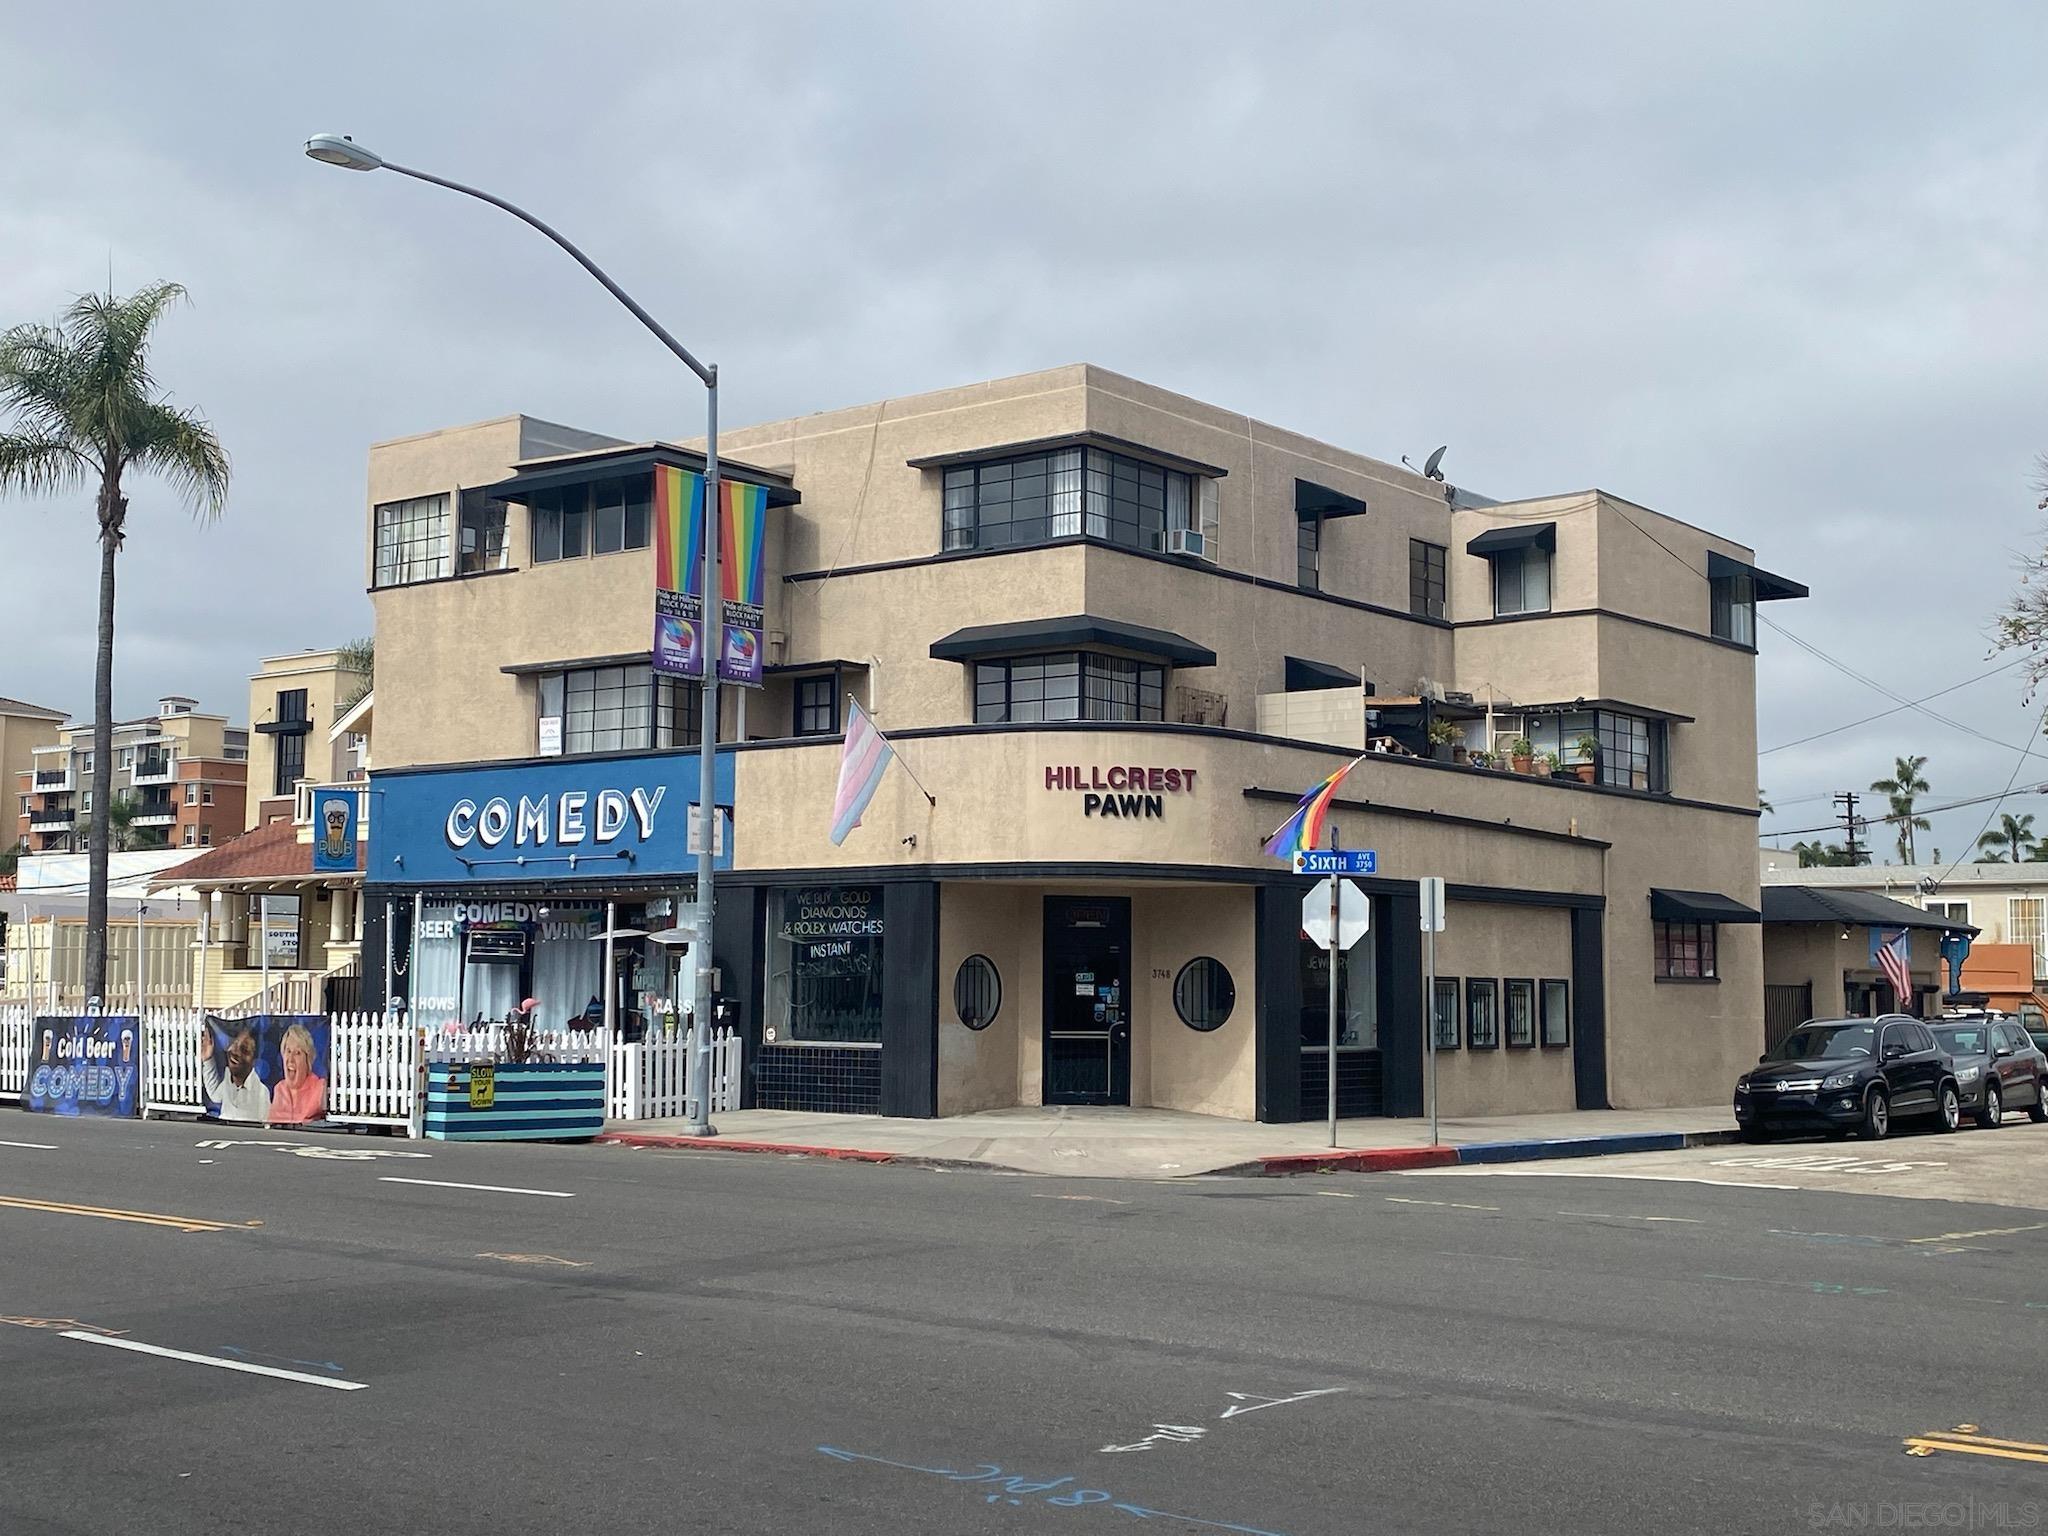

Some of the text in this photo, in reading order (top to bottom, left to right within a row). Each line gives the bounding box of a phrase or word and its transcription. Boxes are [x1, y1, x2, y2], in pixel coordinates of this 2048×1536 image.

[660, 599, 699, 611] BLOCK PARTY
[726, 610, 761, 621] BLOCK PARTY
[663, 660, 689, 670] PRIDE
[728, 669, 751, 678] PRIDE
[1045, 766, 1197, 791] HILLCREST
[1084, 793, 1163, 817] PAWN
[446, 786, 667, 848] COMEDY
[318, 840, 353, 856] PUB
[1357, 852, 1370, 860] AVE
[1309, 854, 1347, 870] SIXTH
[1356, 860, 1372, 868] 3750
[814, 891, 832, 904] BUY
[840, 890, 871, 904] GOLD
[453, 901, 540, 923] COMEDY
[800, 905, 868, 920] DIAMONDS
[419, 919, 454, 939] BEER
[541, 921, 601, 940] WINE
[783, 919, 884, 935] & ROLEX WATCHES
[810, 940, 852, 959] INSTANT
[1152, 969, 1171, 979] 3748
[57, 1036, 116, 1059] Cold Beer
[471, 1067, 494, 1078] SLOW
[30, 1064, 134, 1100] COMEDY
